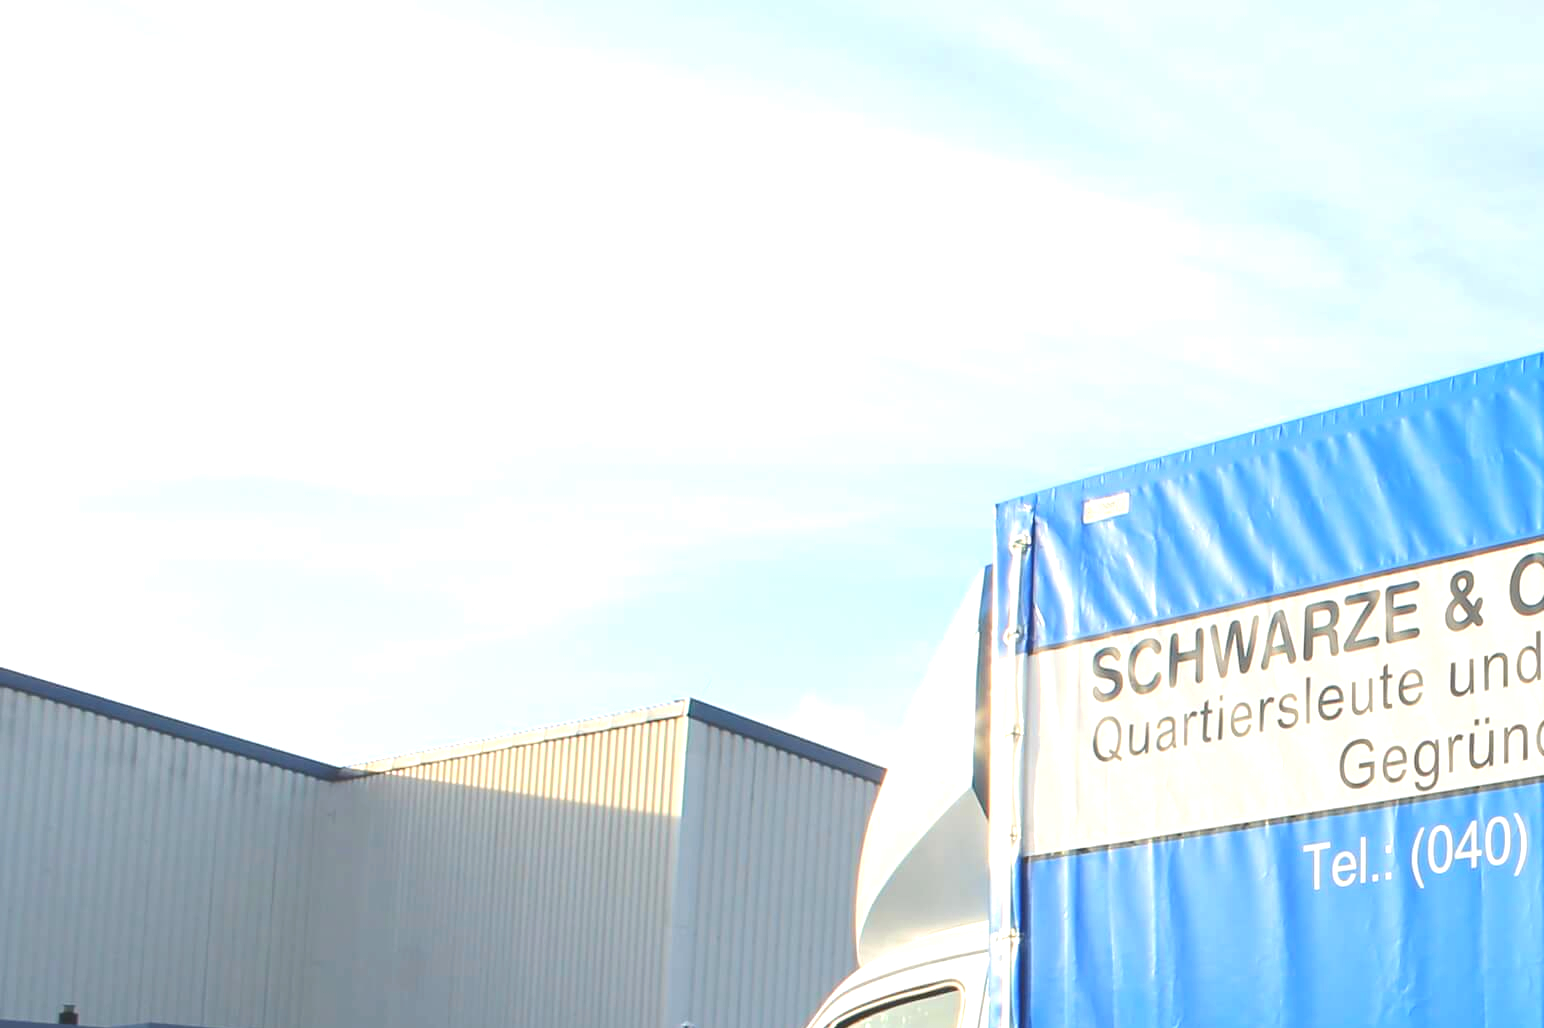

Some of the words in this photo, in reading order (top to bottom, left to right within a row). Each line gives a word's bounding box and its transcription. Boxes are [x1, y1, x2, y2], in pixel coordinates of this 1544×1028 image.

[1092, 663, 1423, 762] Quartiersleute
[1449, 630, 1542, 698] und
[1093, 580, 1420, 702] SCHWARZE
[1445, 570, 1483, 632] &
[1303, 836, 1393, 891] Tel.:
[1411, 812, 1528, 889] (040)
